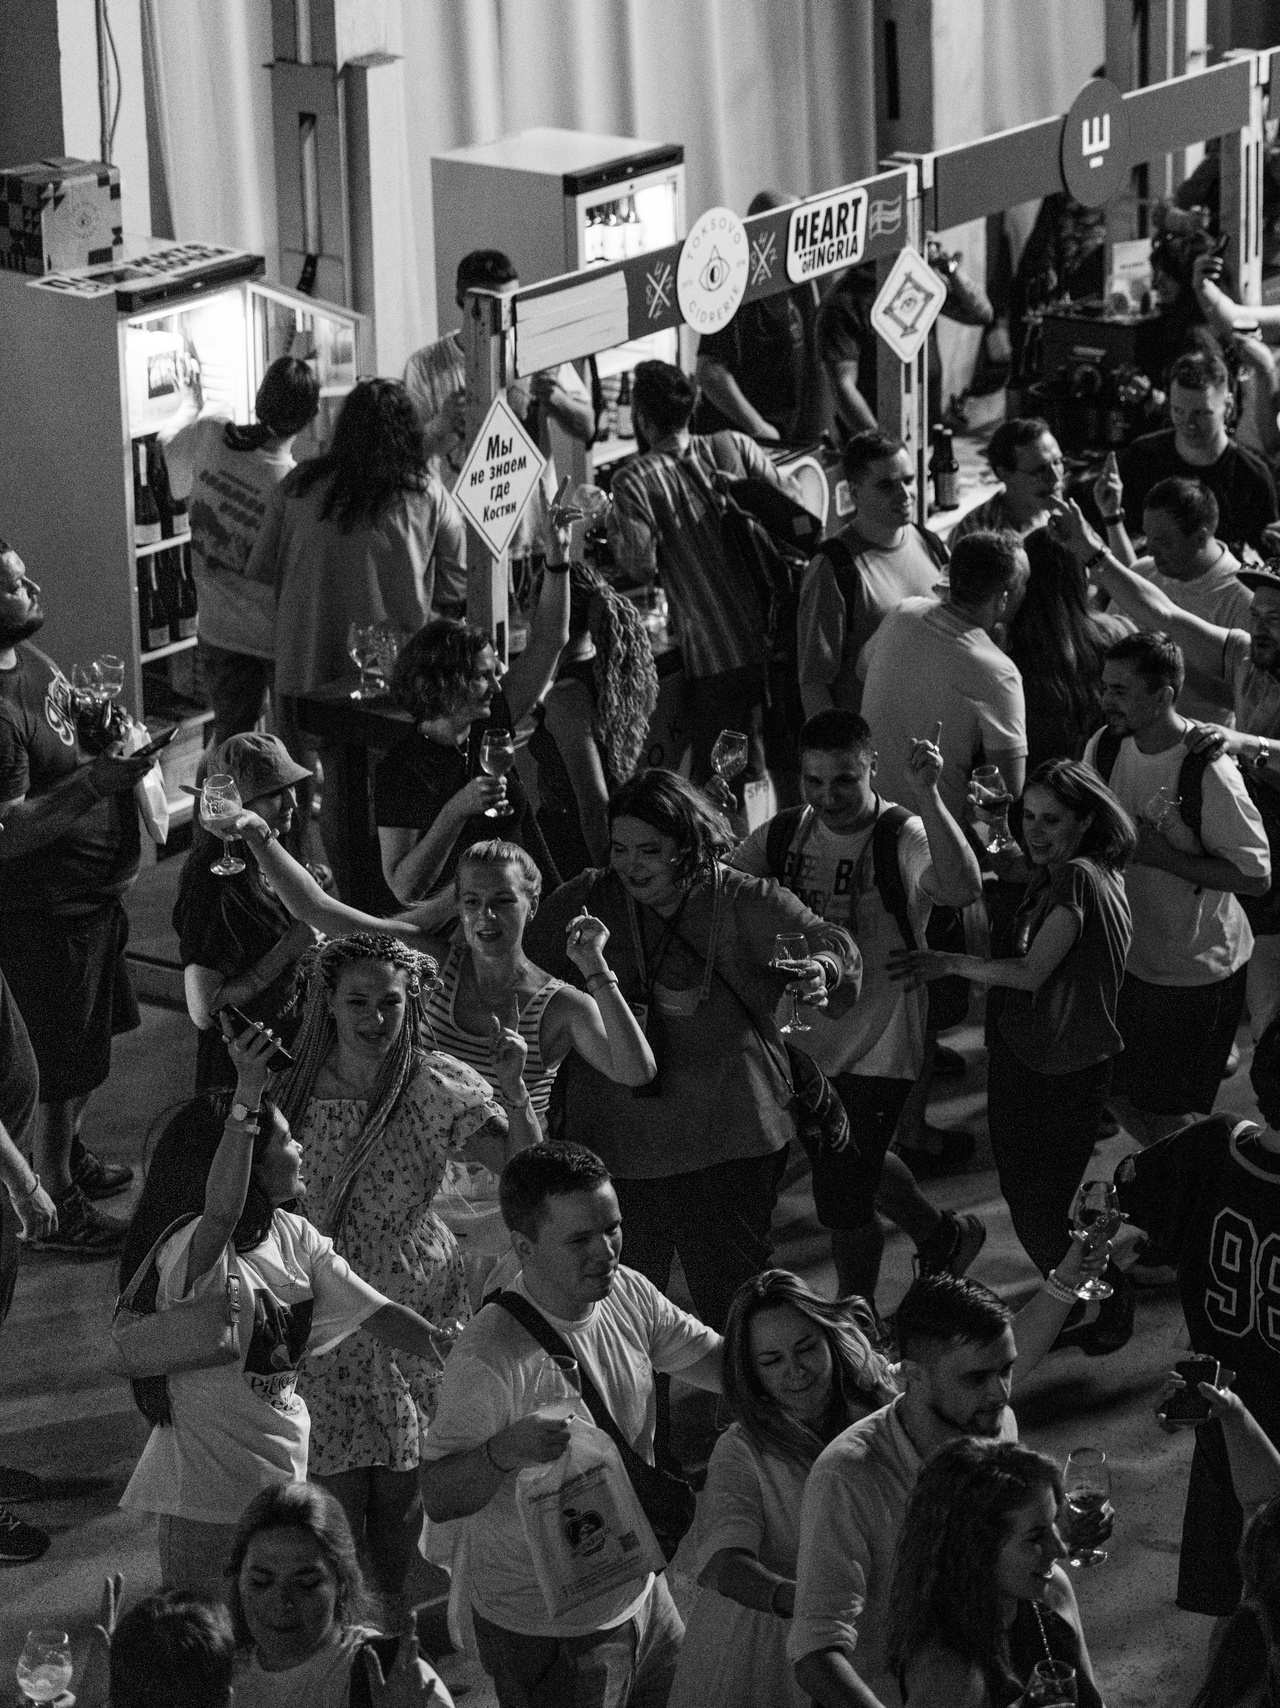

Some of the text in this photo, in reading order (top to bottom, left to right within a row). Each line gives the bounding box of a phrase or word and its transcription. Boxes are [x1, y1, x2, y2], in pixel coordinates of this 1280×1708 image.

[794, 197, 862, 253] HEART
[811, 234, 858, 270] INGRIA
[486, 434, 513, 461] Мы
[470, 455, 527, 487] не знаем
[490, 481, 510, 501] где
[483, 501, 517, 523] Костян
